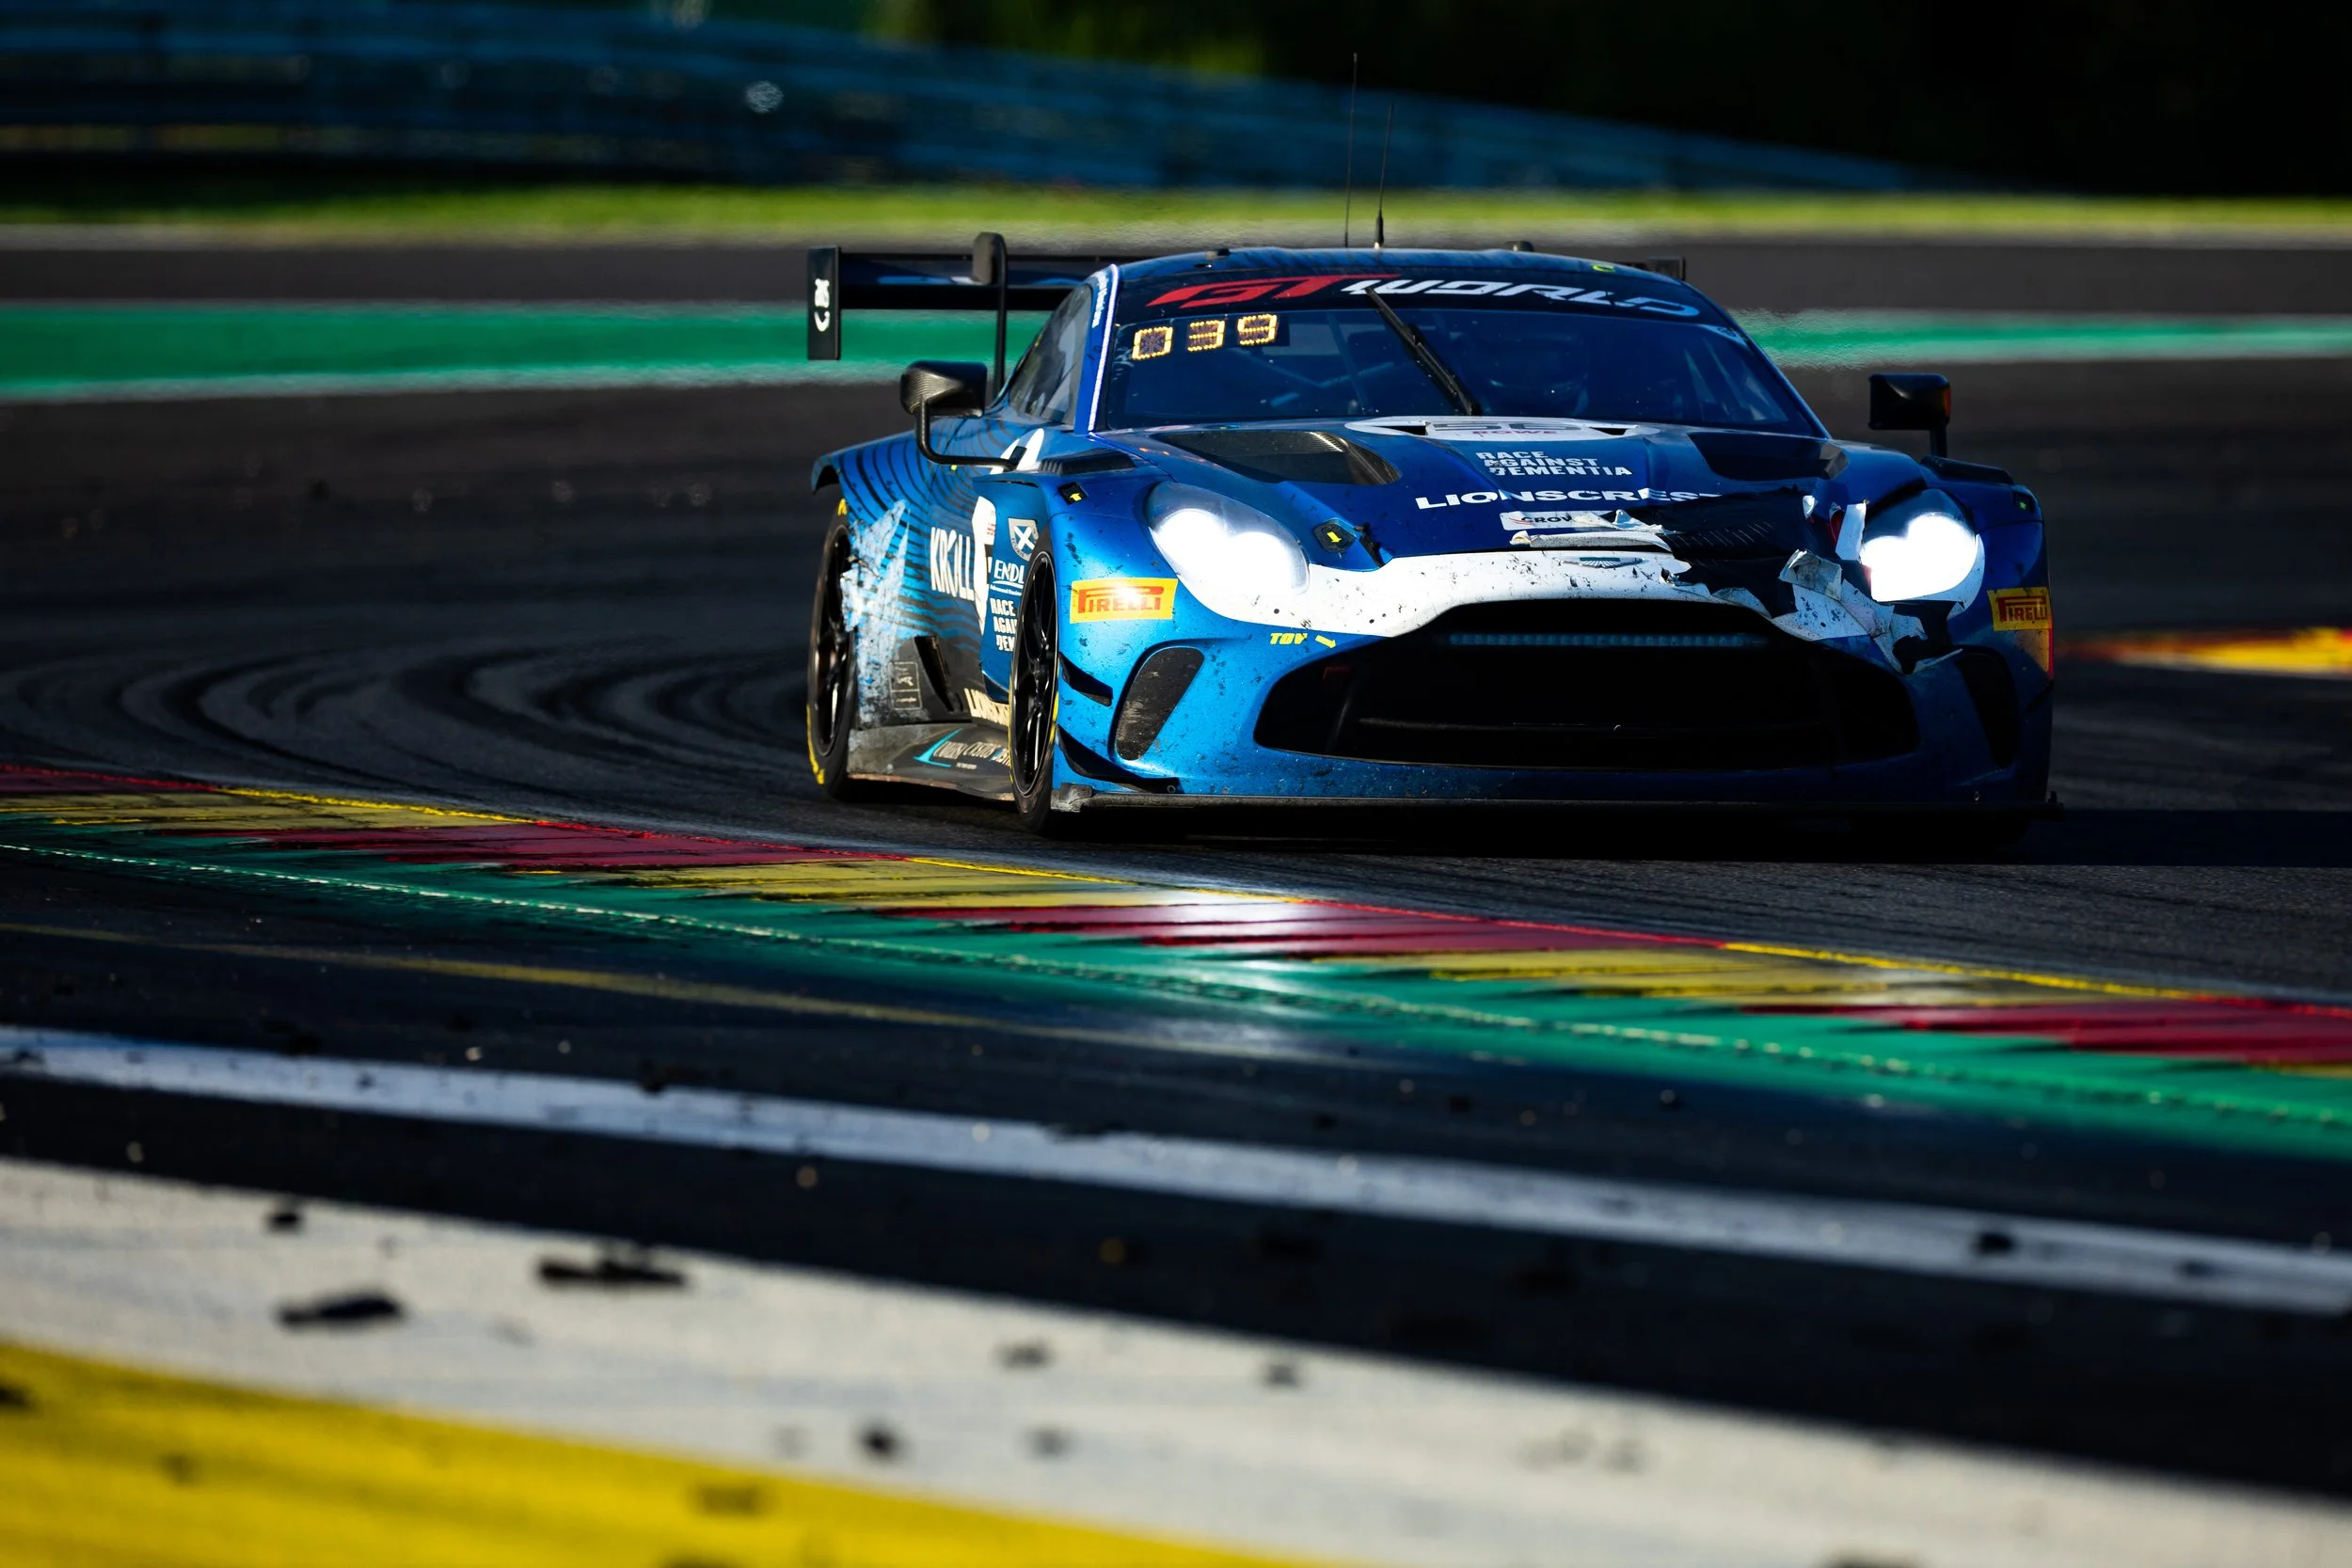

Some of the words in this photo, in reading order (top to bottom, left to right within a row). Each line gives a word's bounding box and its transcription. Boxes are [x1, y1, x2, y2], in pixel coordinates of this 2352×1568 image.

[1145, 274, 1402, 309] GT
[1341, 279, 1700, 317] WORLD
[1132, 313, 1278, 360] 039
[1475, 451, 1549, 460] RACE
[1484, 458, 1597, 467] AGAINST
[1488, 467, 1633, 476] DEMENTIA
[990, 597, 1016, 616] RACE
[1078, 586, 1165, 613] PIRELLI
[1996, 595, 2048, 623] PIRELLI
